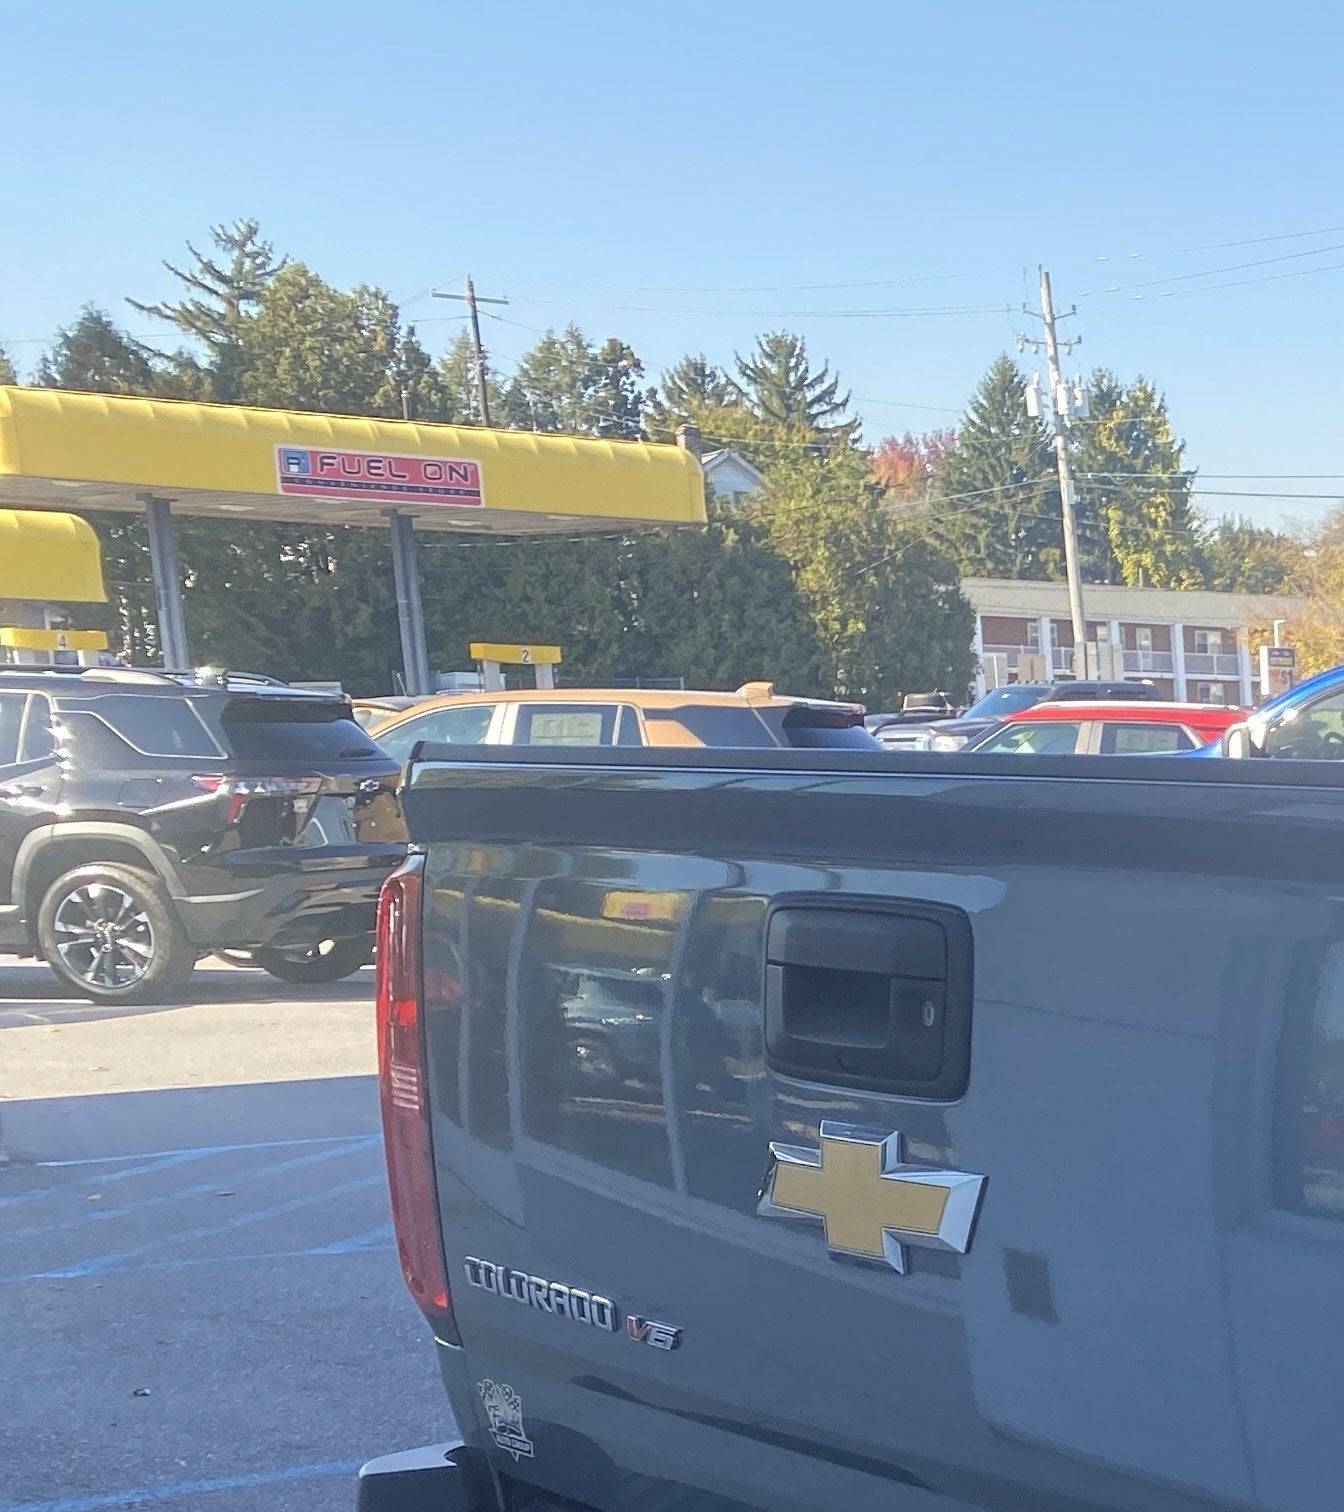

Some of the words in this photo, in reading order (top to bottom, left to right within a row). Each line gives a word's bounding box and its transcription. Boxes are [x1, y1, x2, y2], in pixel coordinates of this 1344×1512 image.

[319, 455, 407, 479] FUEL
[423, 462, 470, 483] ON
[521, 649, 530, 663] 2
[464, 1255, 620, 1333] COLORADO
[626, 1313, 683, 1351] V6
